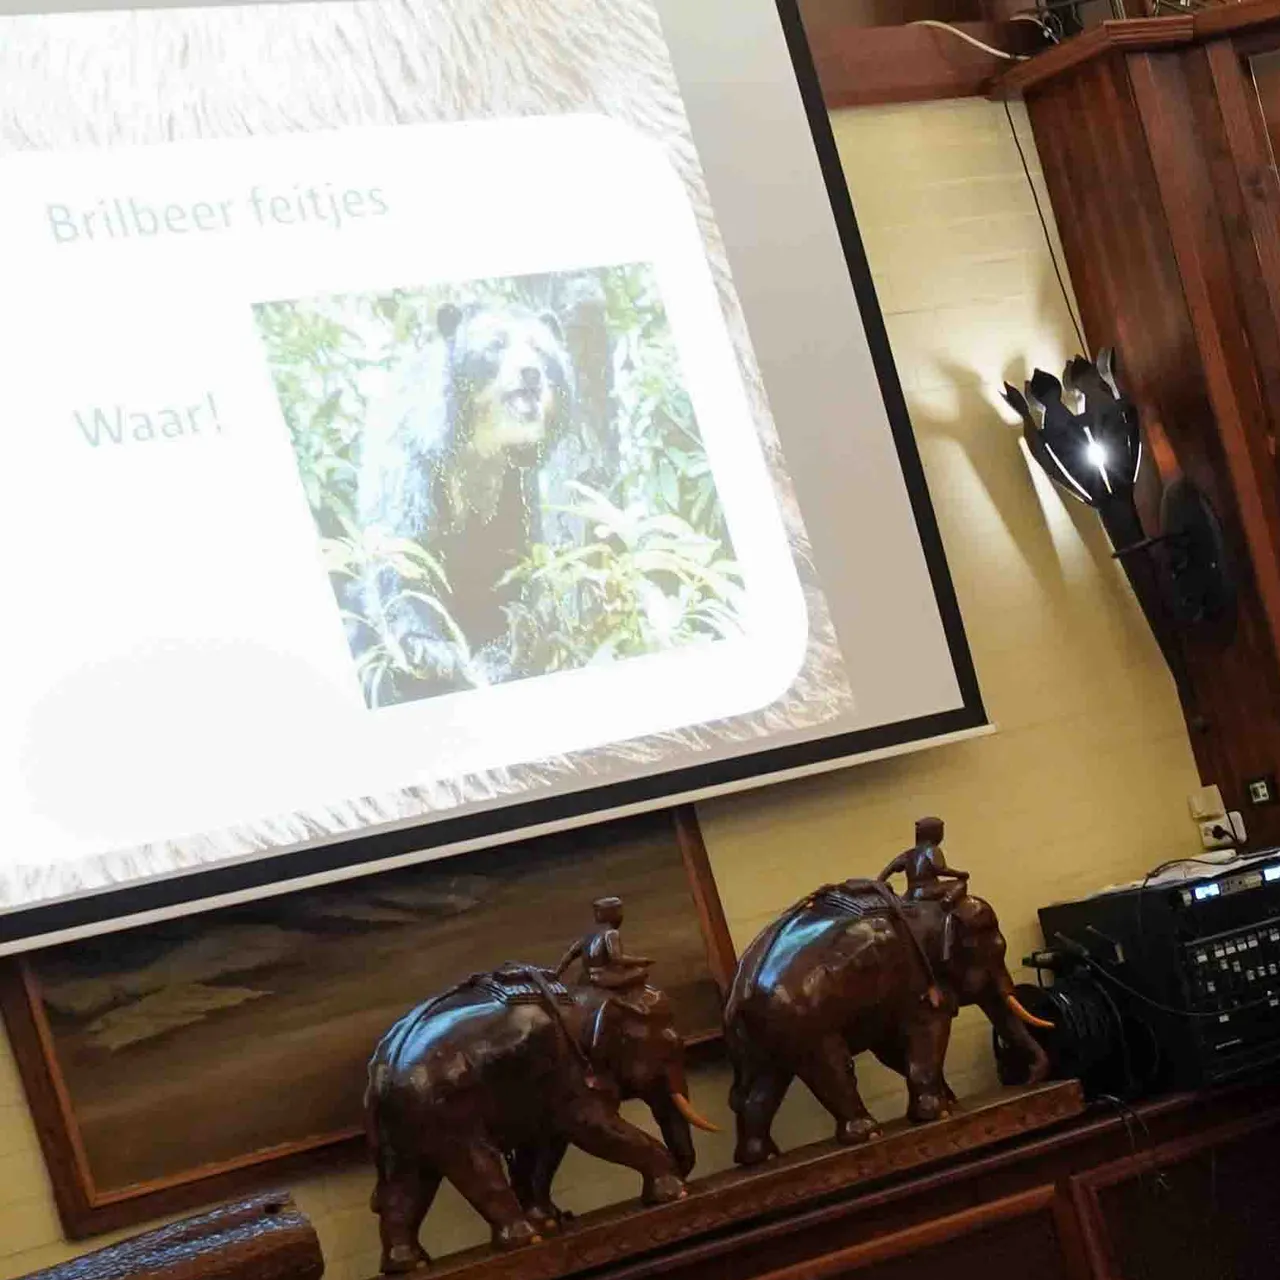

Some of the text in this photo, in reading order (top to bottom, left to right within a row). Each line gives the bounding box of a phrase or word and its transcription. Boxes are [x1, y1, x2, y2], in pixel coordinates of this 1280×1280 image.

[46, 183, 390, 244] Brilbeer feitjes
[73, 392, 222, 448] Waar!
